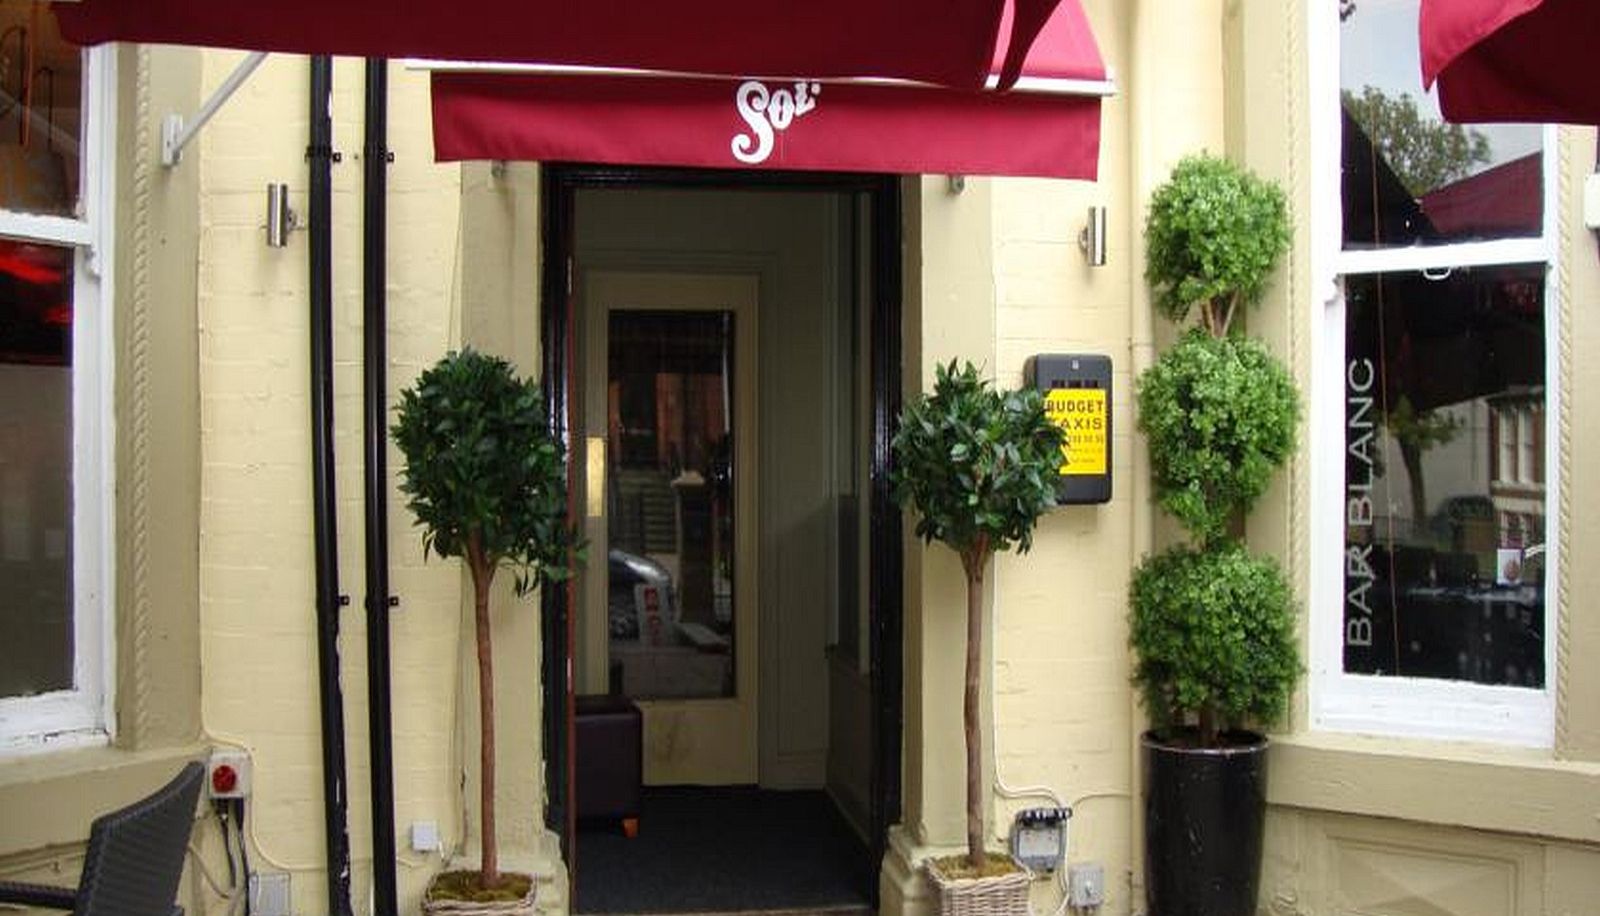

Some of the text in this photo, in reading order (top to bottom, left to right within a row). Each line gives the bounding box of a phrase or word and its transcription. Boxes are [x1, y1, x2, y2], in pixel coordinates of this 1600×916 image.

[1046, 399, 1104, 414] BUDGET
[1347, 357, 1374, 646] BAR BLANC
